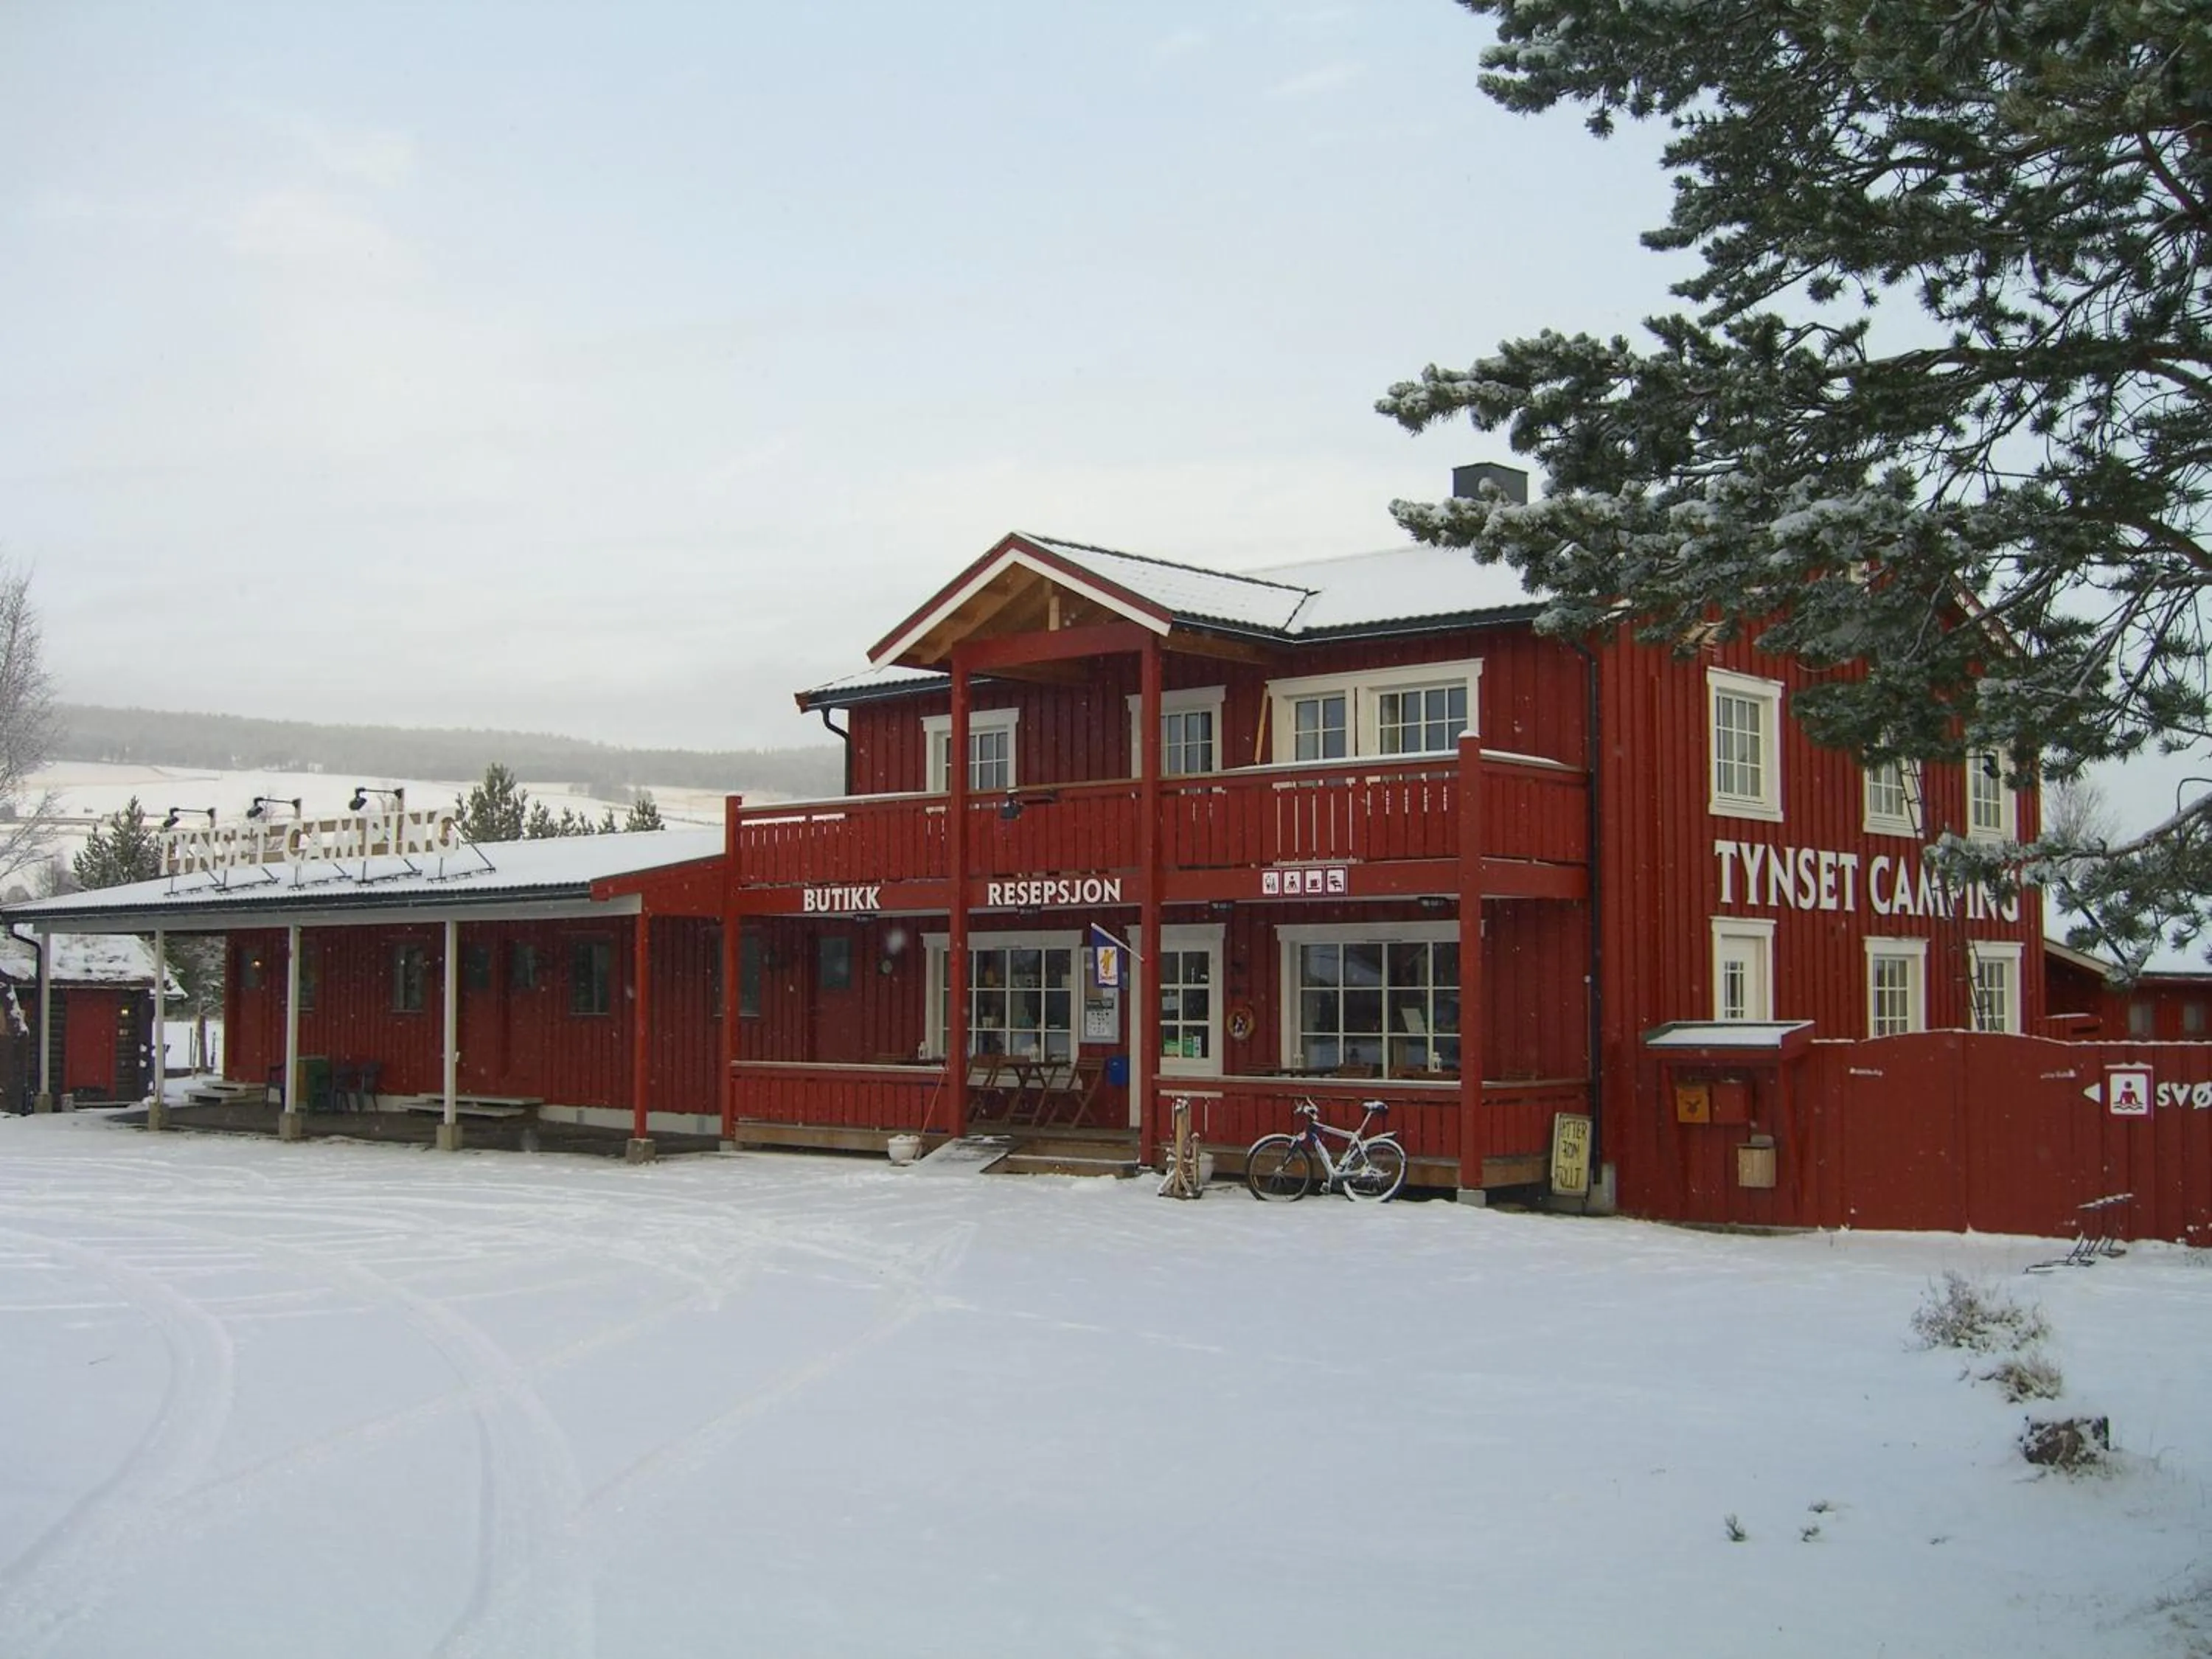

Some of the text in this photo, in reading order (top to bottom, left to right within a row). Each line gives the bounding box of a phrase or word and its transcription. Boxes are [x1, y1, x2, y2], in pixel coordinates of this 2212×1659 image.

[159, 808, 459, 874] TYNSET CAMPING
[803, 886, 881, 912] BUTIKK
[987, 878, 1121, 906] RESEPSJON
[1714, 840, 1858, 911] TYNSET
